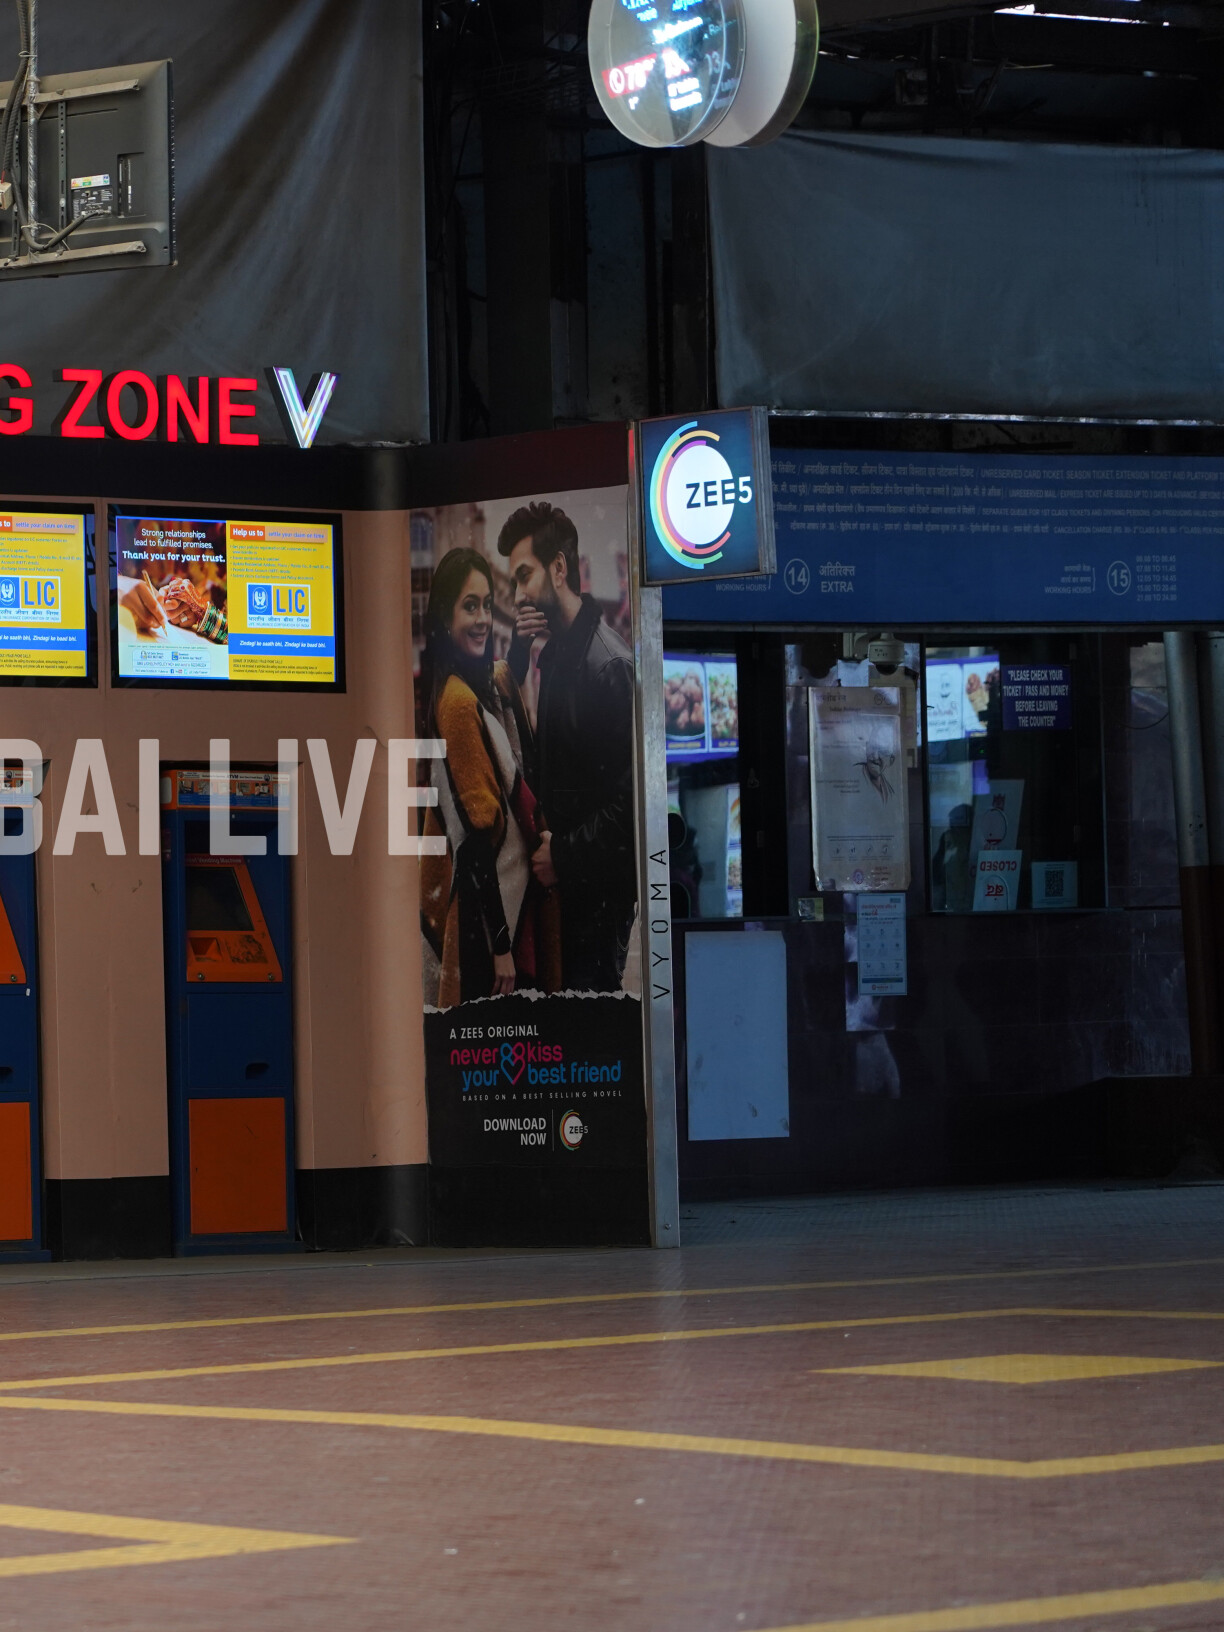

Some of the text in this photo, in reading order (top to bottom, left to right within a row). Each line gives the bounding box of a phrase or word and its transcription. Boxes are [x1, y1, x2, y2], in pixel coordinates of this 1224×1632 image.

[61, 368, 259, 446] ZONE
[685, 475, 753, 509] ZEE5
[141, 528, 206, 540] Strong relationships
[232, 527, 247, 537] Help
[257, 529, 264, 537] to
[134, 538, 147, 546] lead
[157, 538, 182, 548] fulfilled
[183, 540, 213, 549] promises.
[122, 550, 226, 563] Thank you for your trust.
[788, 566, 807, 585] 14
[819, 561, 856, 577] अतिरिक्त
[1111, 568, 1128, 588] 15
[24, 580, 55, 606] LIC
[716, 583, 767, 592] WORKING HOURS
[821, 581, 854, 593] EXTRA
[276, 589, 305, 614] LIC
[1030, 669, 1048, 681] CHECK
[1049, 669, 1063, 681] YOUR
[1003, 685, 1022, 696] TICKET
[1025, 685, 1038, 696] PASS
[1039, 685, 1050, 696] AND
[1050, 685, 1069, 696] MONEY
[1015, 700, 1058, 712] BEFORE LEAVING
[1018, 716, 1029, 727] THE
[980, 860, 1017, 871] CLOSED
[649, 848, 671, 1000] VYOMA
[449, 1025, 539, 1039] A ZEE5 ORIGINAL
[450, 1041, 563, 1066] never kiss
[462, 1060, 621, 1092] your best friend
[549, 1091, 587, 1099] SELLING
[484, 1117, 546, 1131] DOWNLOAD
[569, 1125, 588, 1134] ZEE5
[520, 1132, 547, 1146] NOW
